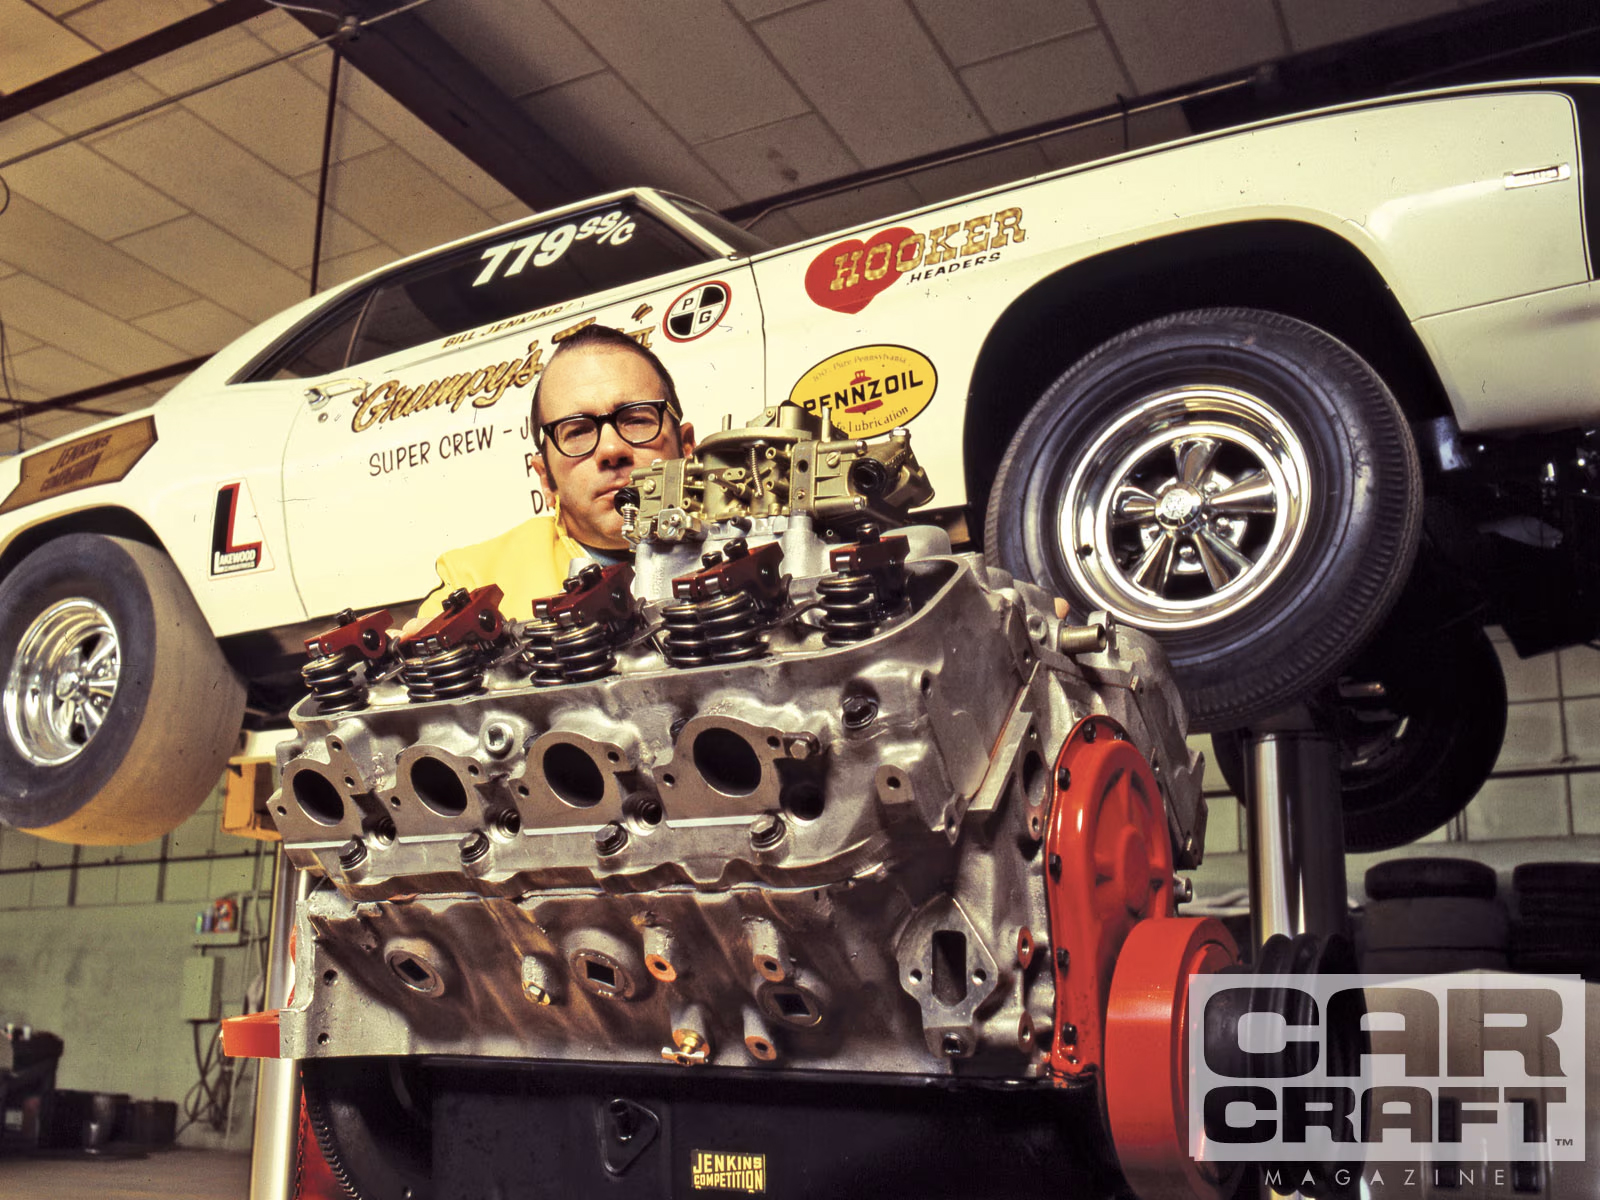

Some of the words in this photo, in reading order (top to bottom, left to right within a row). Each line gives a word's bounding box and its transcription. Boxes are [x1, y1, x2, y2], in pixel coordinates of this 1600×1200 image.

[472, 224, 577, 287] 779
[830, 207, 1026, 291] HOOKER
[910, 252, 1001, 283] HEADERS
[682, 298, 694, 311] P
[698, 310, 712, 325] G
[442, 331, 476, 349] BILL
[803, 370, 923, 412] PENNZOIL
[849, 406, 909, 432] Lubrication
[369, 441, 430, 477] SUPER
[439, 425, 493, 459] CREW
[213, 549, 256, 574] LAKEWOOD
[693, 1153, 762, 1174] JENKINS
[694, 1169, 763, 1190] COMPETITION
